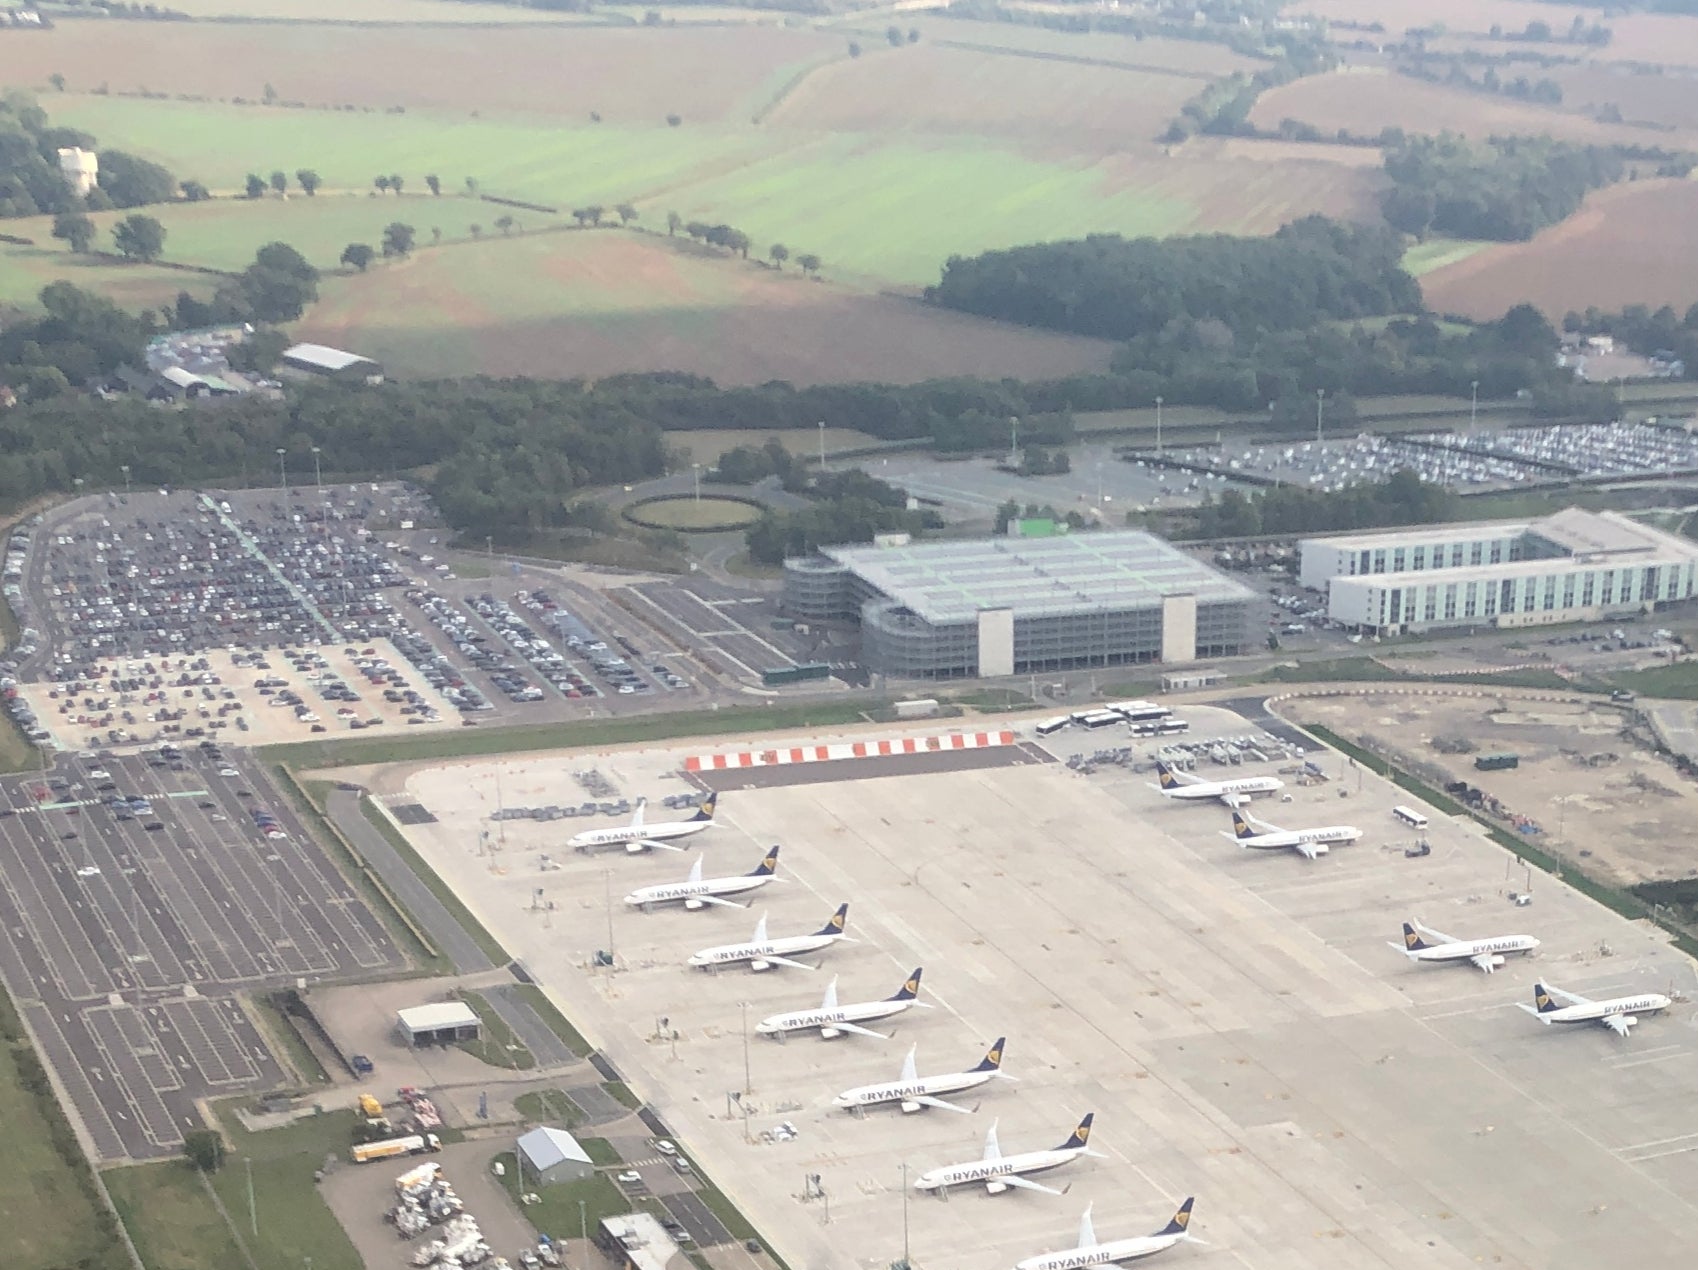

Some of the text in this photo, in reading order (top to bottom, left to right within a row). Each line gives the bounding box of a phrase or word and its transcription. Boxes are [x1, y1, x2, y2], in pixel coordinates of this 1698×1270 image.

[597, 830, 648, 842] RYANAIR
[656, 886, 709, 898] RYANAIR
[720, 946, 774, 959] RYANAIR
[1473, 941, 1518, 954] RYANAIR
[1604, 1001, 1650, 1013] RYANAIR
[789, 1012, 845, 1026] RYANAIR
[867, 1085, 925, 1100] RYANAIR
[953, 1164, 1013, 1181] RYANAIR
[1048, 1252, 1110, 1270] RYANAIR
